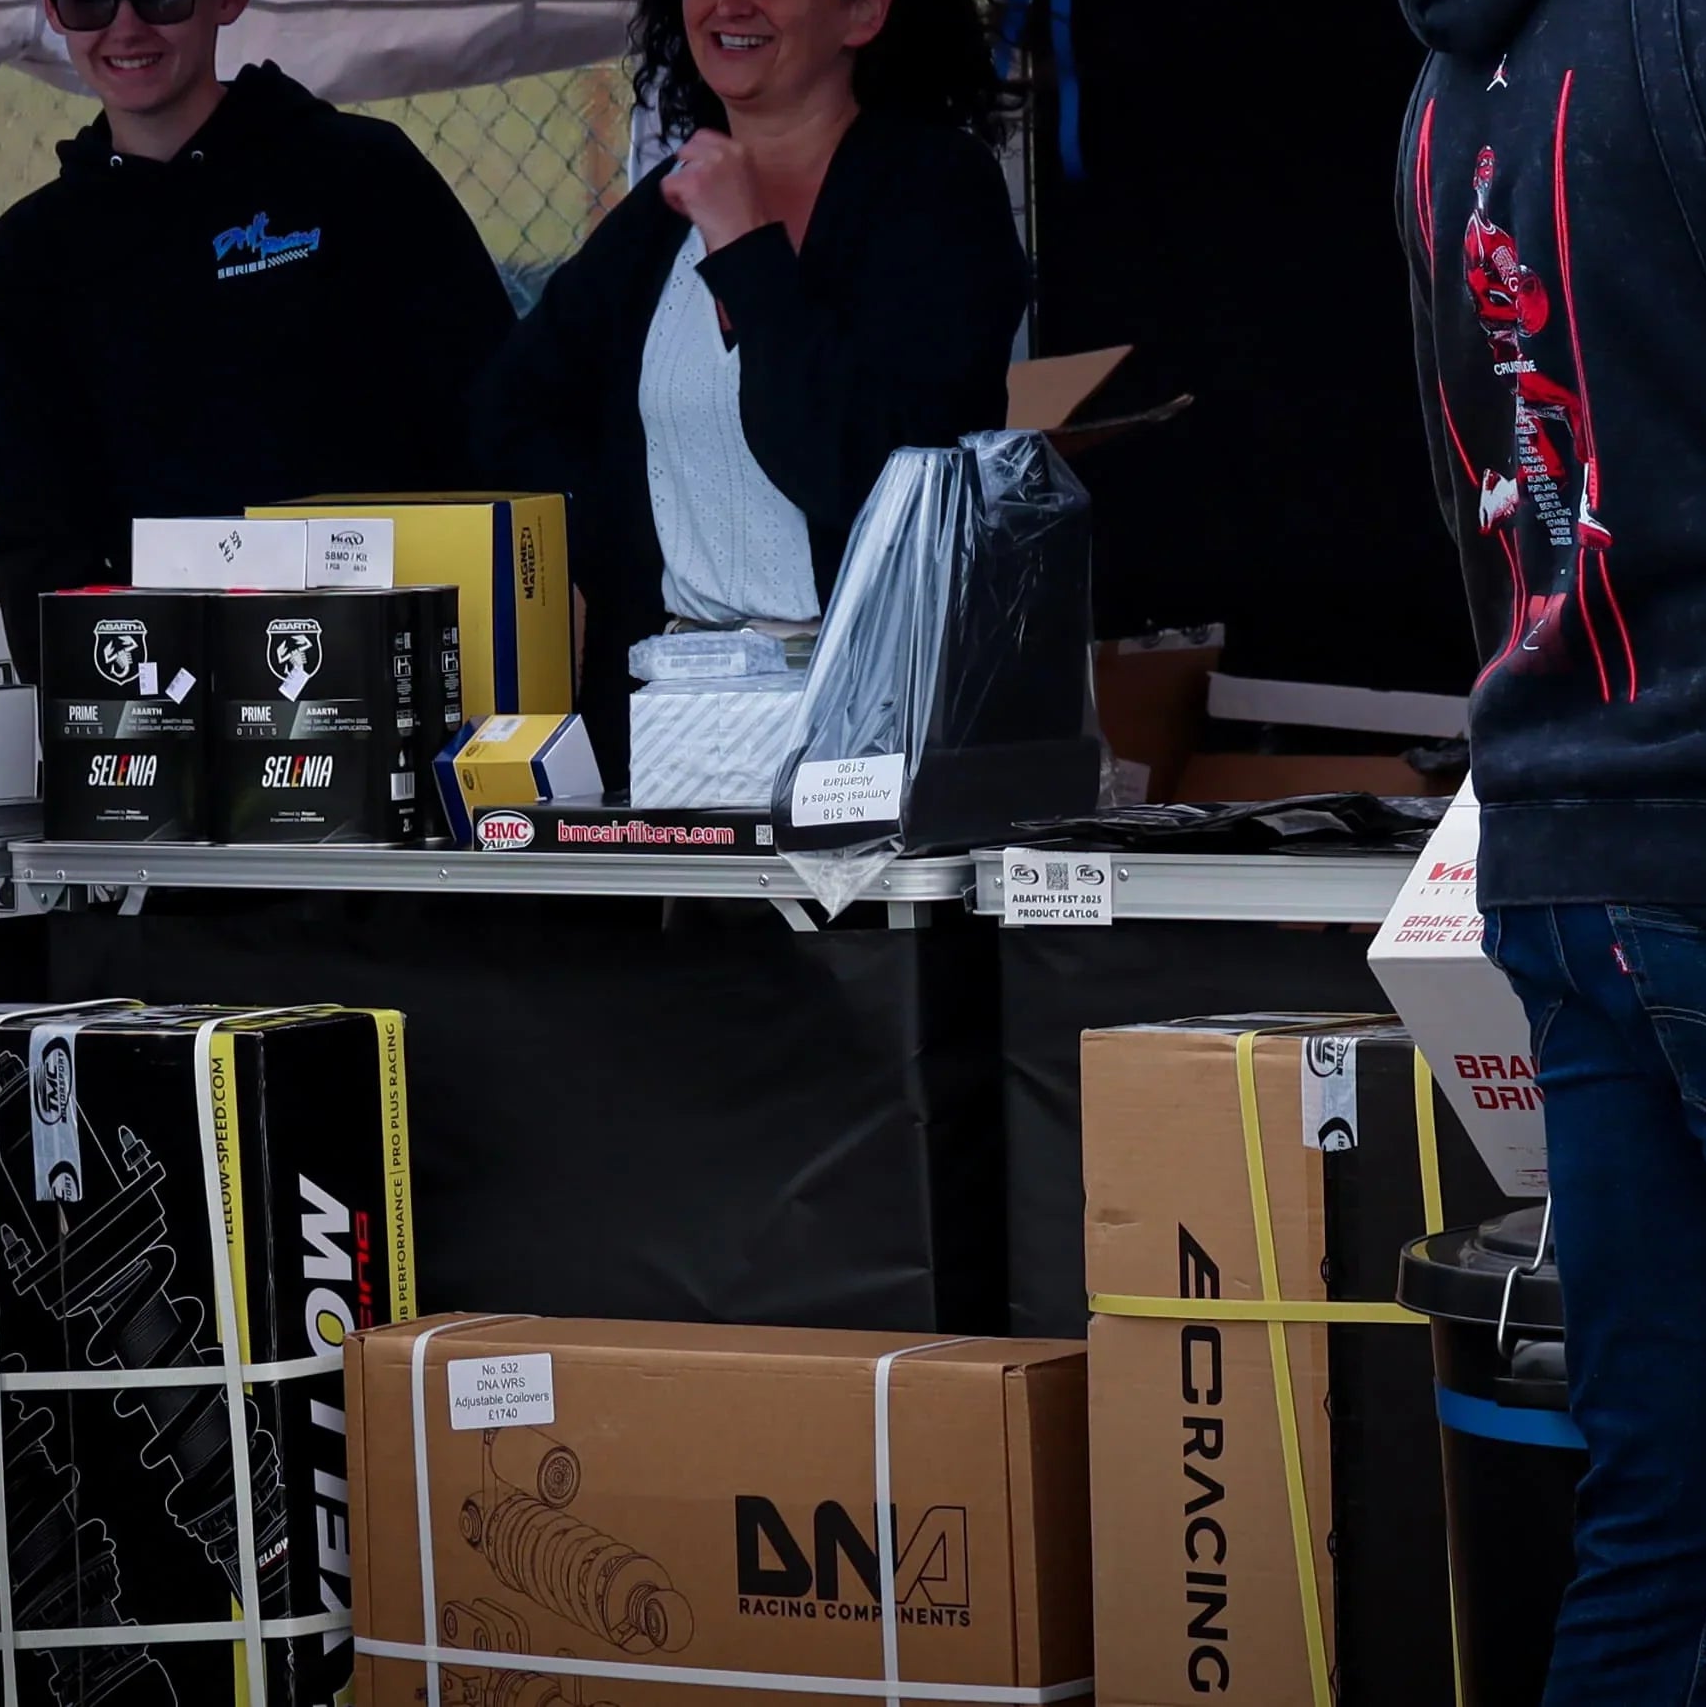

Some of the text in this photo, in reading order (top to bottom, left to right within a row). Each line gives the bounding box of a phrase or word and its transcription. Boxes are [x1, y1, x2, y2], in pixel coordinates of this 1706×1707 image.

[217, 260, 267, 280] SERIES
[98, 623, 142, 632] ABARTH
[271, 623, 318, 631] ABARTH
[69, 705, 98, 722] PRIME
[131, 707, 163, 717] ABARTH
[241, 705, 272, 722] PRIME
[306, 707, 338, 716] ABARTH
[64, 726, 104, 735] OILS
[236, 726, 277, 736] OILS
[88, 754, 157, 787] SELENIA
[261, 755, 333, 788] SELENIA
[837, 762, 865, 774] £190
[822, 774, 874, 787] Alcantara
[801, 789, 891, 805] Armrest Series 4
[822, 805, 865, 820] No. 518
[483, 821, 529, 840] BMC
[558, 819, 735, 845] bmcairfilters.com
[1012, 894, 1102, 904] ABARTHS FEST 2025
[1017, 908, 1061, 919] PRODUCT
[1402, 915, 1468, 928] BRAKE
[1394, 930, 1451, 943] DRIVE
[387, 1022, 401, 1087] RACING
[45, 1061, 59, 1114] TMC
[390, 1089, 402, 1128] PLUS
[392, 1130, 402, 1168] PRO
[395, 1177, 407, 1309] PERFORMANCE
[482, 1362, 518, 1375] No. 532
[476, 1377, 526, 1391] DNA WRS
[454, 1392, 550, 1410] Adjustable Coilovers
[488, 1408, 518, 1421] £1740
[735, 1494, 970, 1608] DNA
[1182, 1415, 1230, 1693] RACING
[738, 1597, 971, 1627] RACING COMPNENTS
